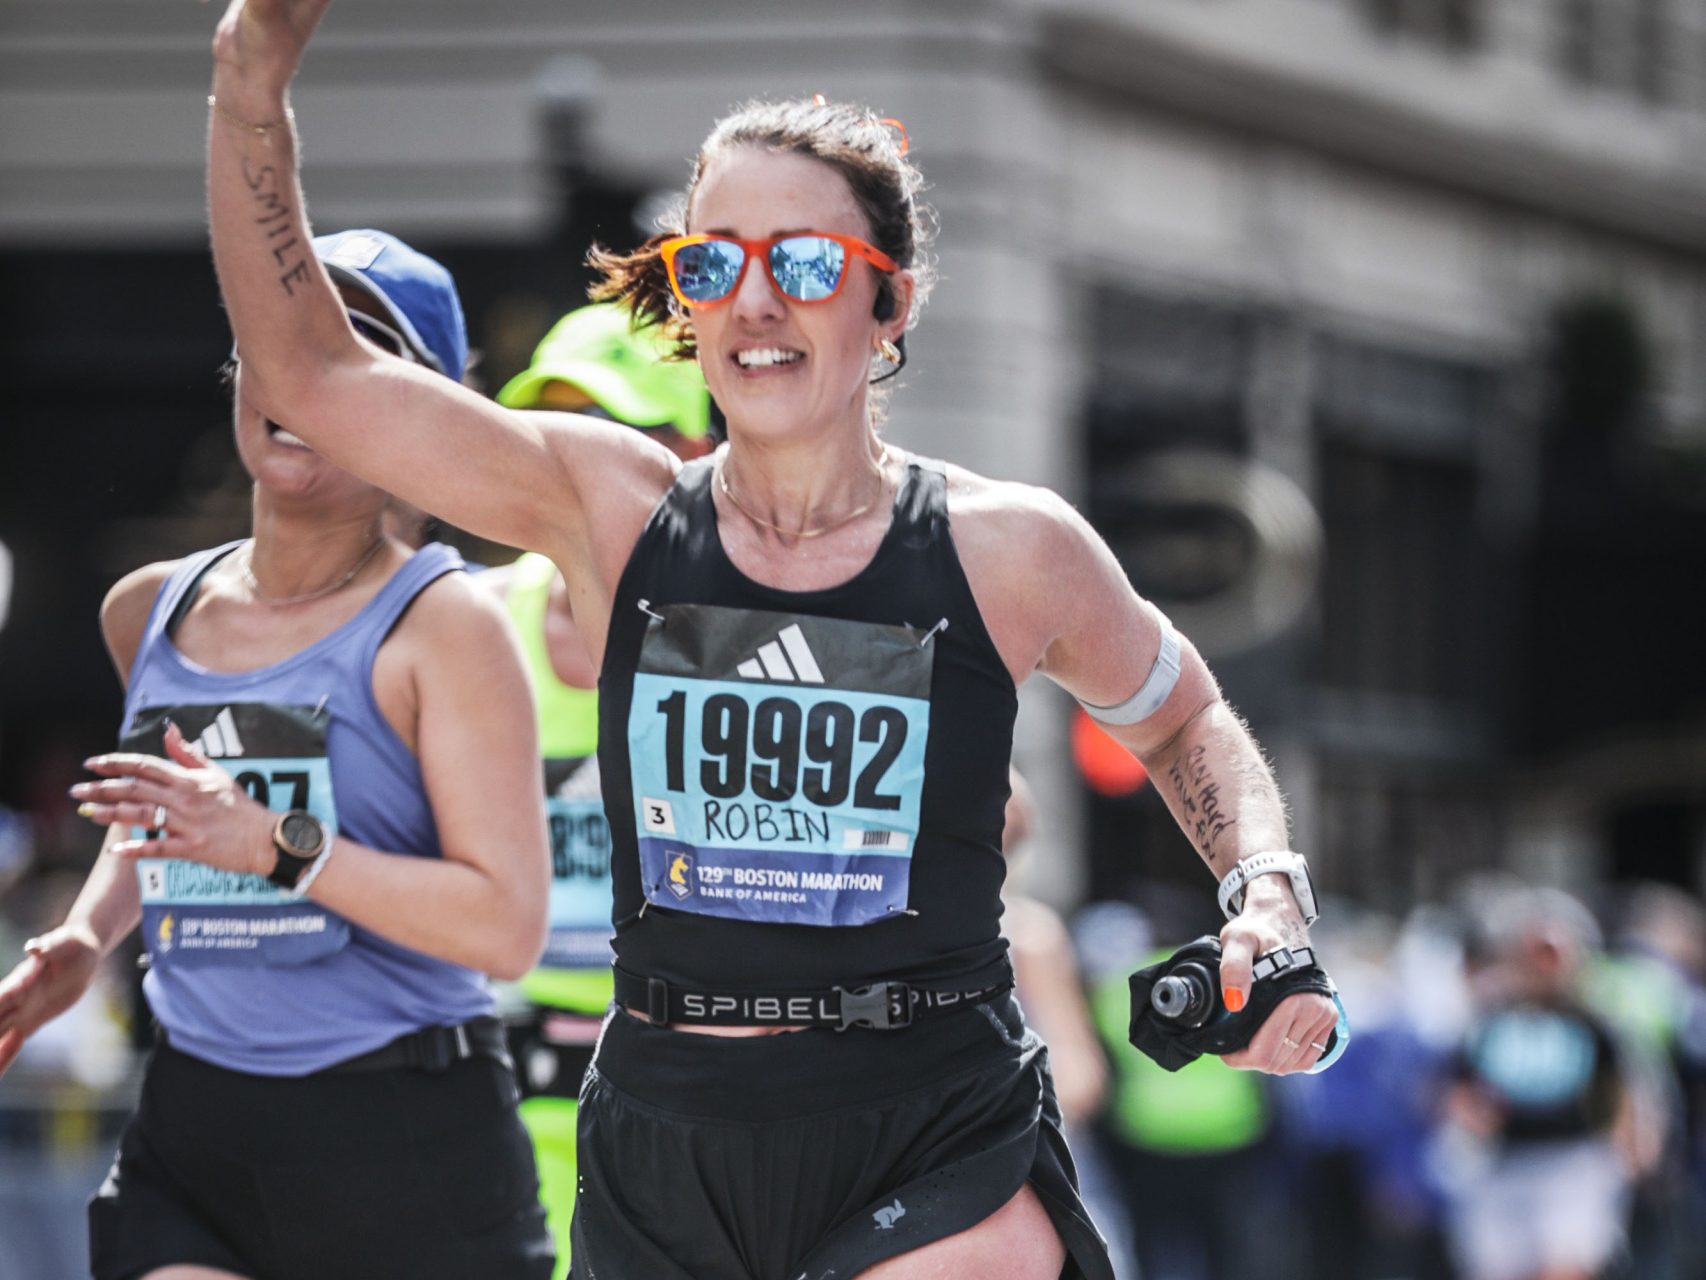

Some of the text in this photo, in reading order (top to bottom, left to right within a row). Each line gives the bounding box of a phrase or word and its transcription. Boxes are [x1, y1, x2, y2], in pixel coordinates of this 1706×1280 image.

[241, 157, 311, 296] SMILE
[656, 690, 909, 812] 19992
[651, 806, 666, 825] 3
[703, 800, 831, 843] ROBIN
[734, 868, 799, 889] BOSTON
[801, 871, 884, 892] MARATHON
[700, 886, 807, 904] BANK OF AMERICA
[203, 917, 247, 937] BOSTON
[250, 914, 326, 937] MARATHON
